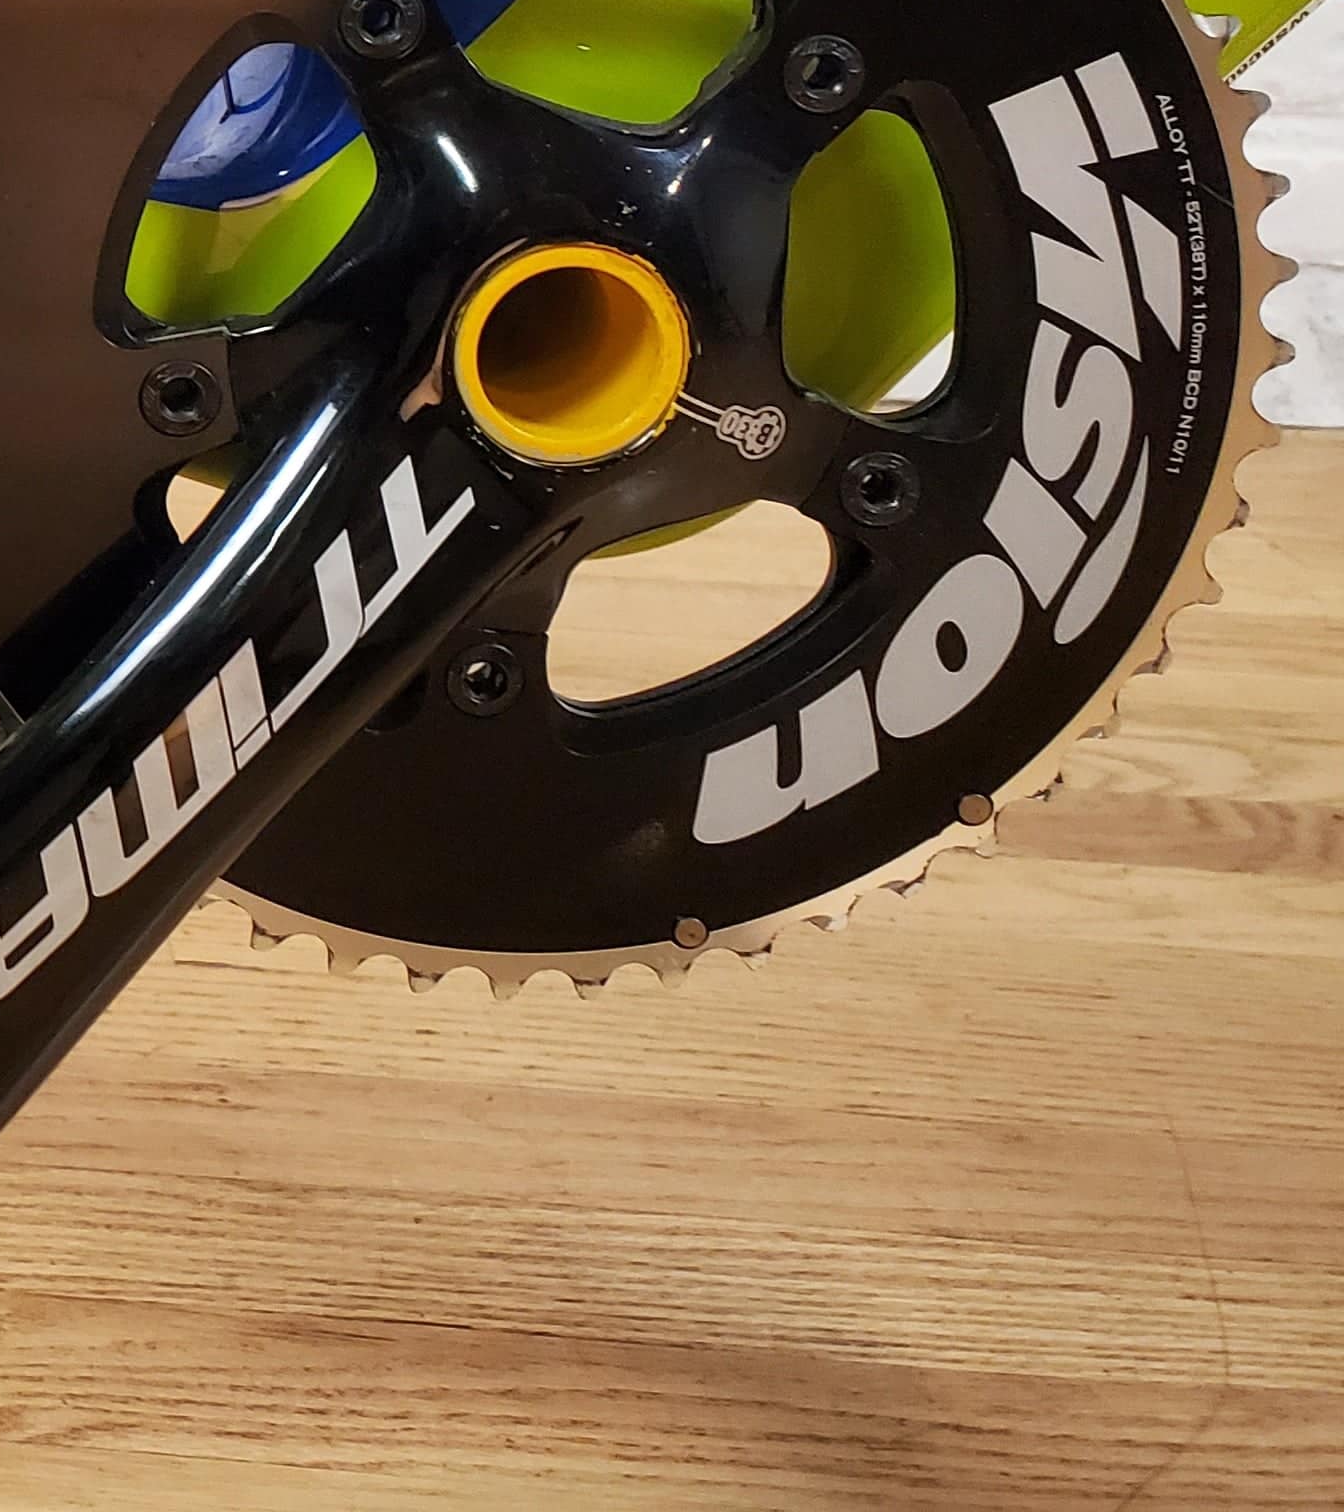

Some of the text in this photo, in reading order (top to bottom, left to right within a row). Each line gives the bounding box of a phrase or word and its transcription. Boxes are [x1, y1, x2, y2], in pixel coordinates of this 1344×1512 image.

[1154, 94, 1189, 156] ALLOY
[1177, 159, 1197, 186] TT
[1192, 285, 1205, 297] x
[1188, 303, 1209, 364] 110mm
[1183, 369, 1203, 411] BCD
[1165, 414, 1196, 475] N10/11
